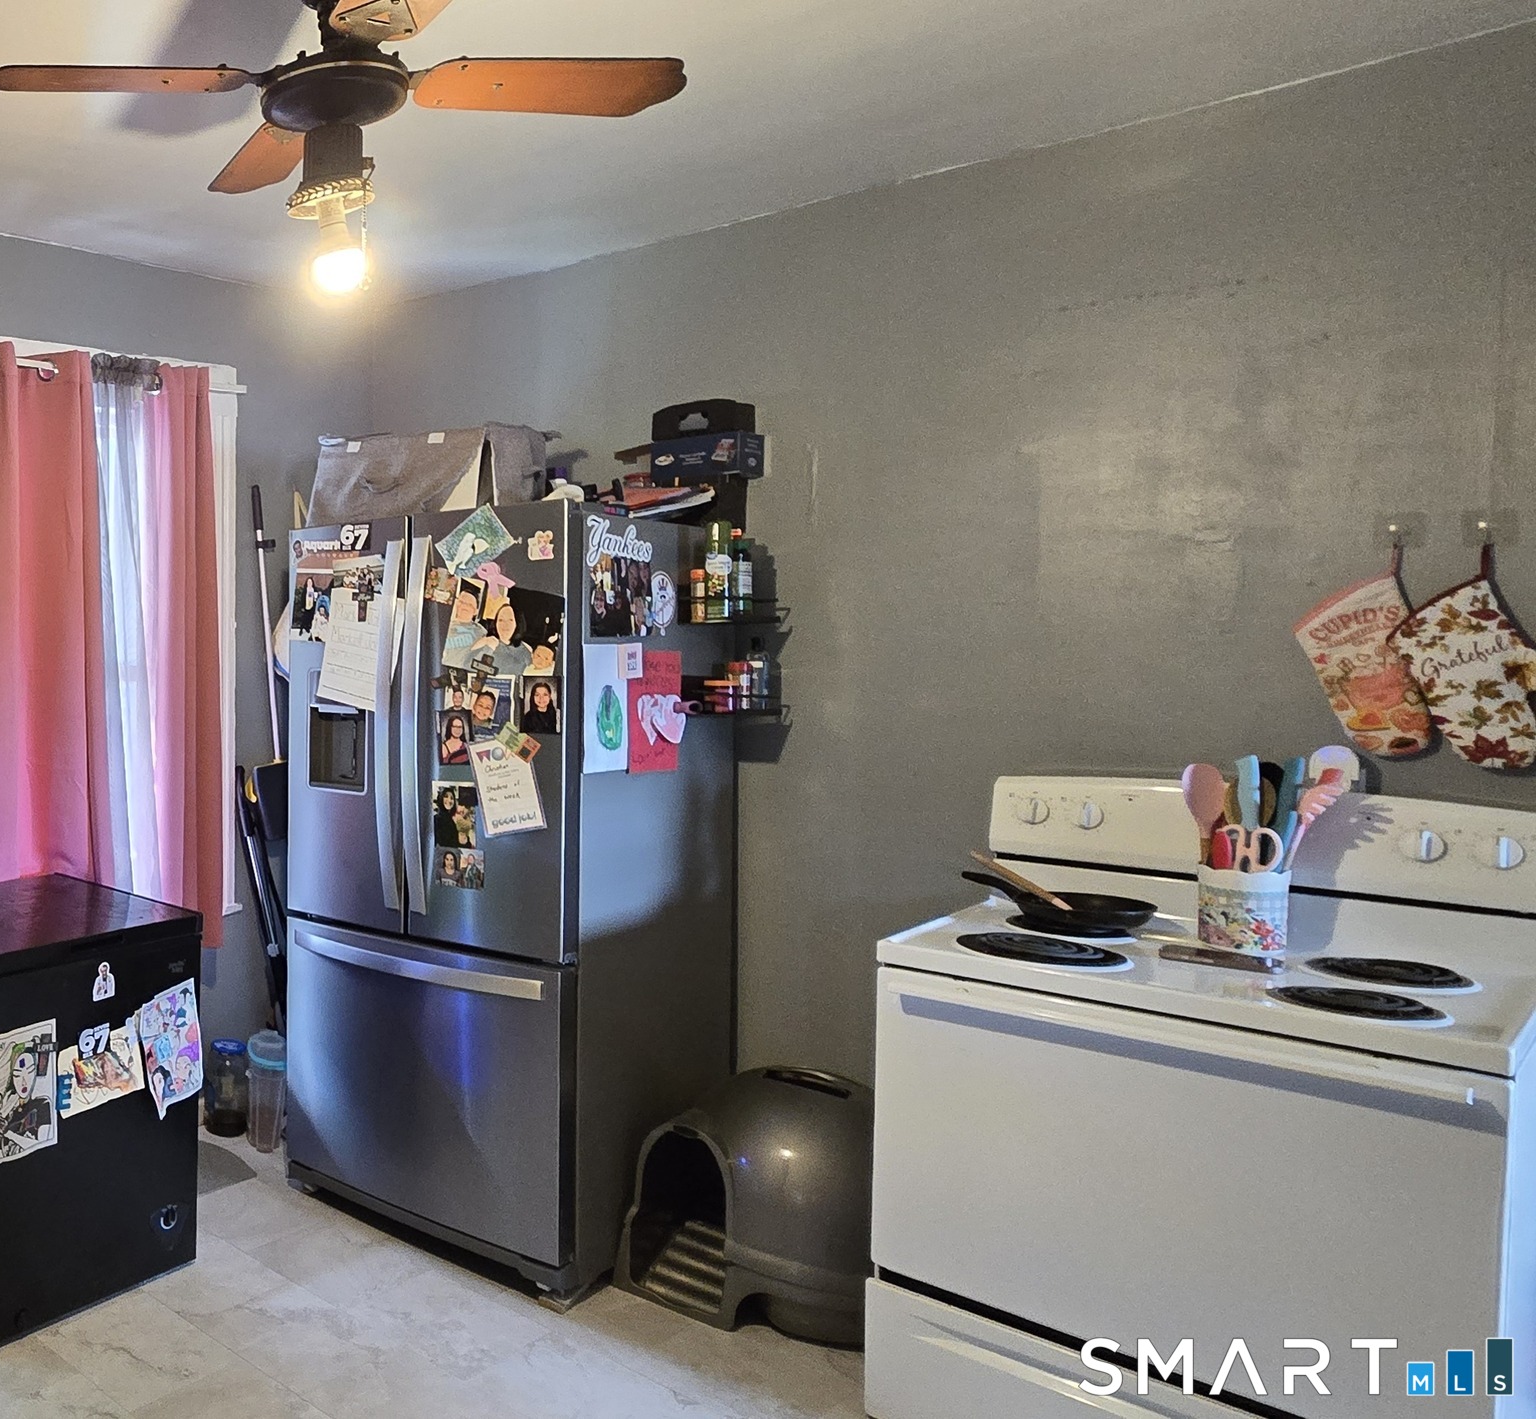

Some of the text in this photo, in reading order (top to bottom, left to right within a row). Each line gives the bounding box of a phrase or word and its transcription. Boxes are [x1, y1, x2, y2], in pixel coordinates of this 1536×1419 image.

[304, 540, 340, 553] Aquari
[340, 525, 369, 550] 67
[586, 515, 653, 567] Yankees
[1309, 605, 1401, 641] CUPID'S
[1421, 634, 1508, 679] Grateful
[78, 1027, 110, 1053] 67
